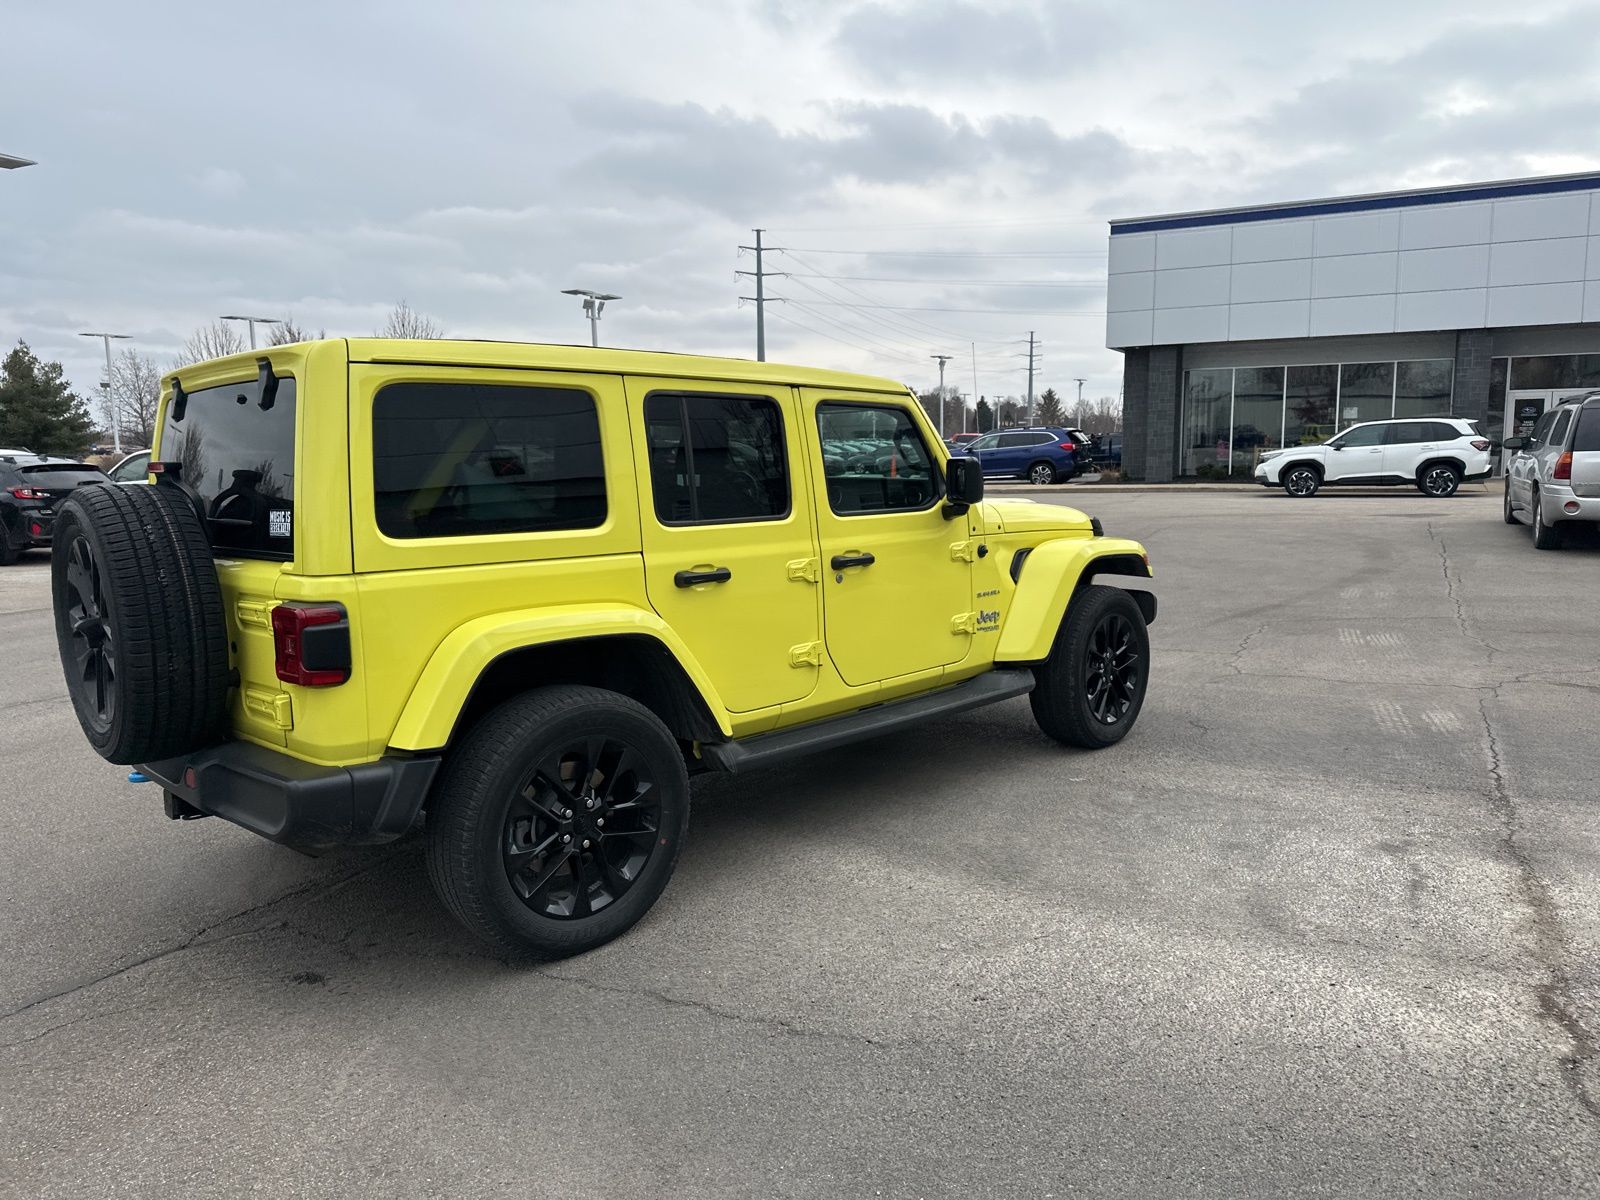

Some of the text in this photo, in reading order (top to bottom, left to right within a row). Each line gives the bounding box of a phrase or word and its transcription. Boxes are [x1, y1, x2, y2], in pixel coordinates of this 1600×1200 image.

[269, 511, 291, 523] MUSIC IS
[976, 610, 999, 624] Jeep
